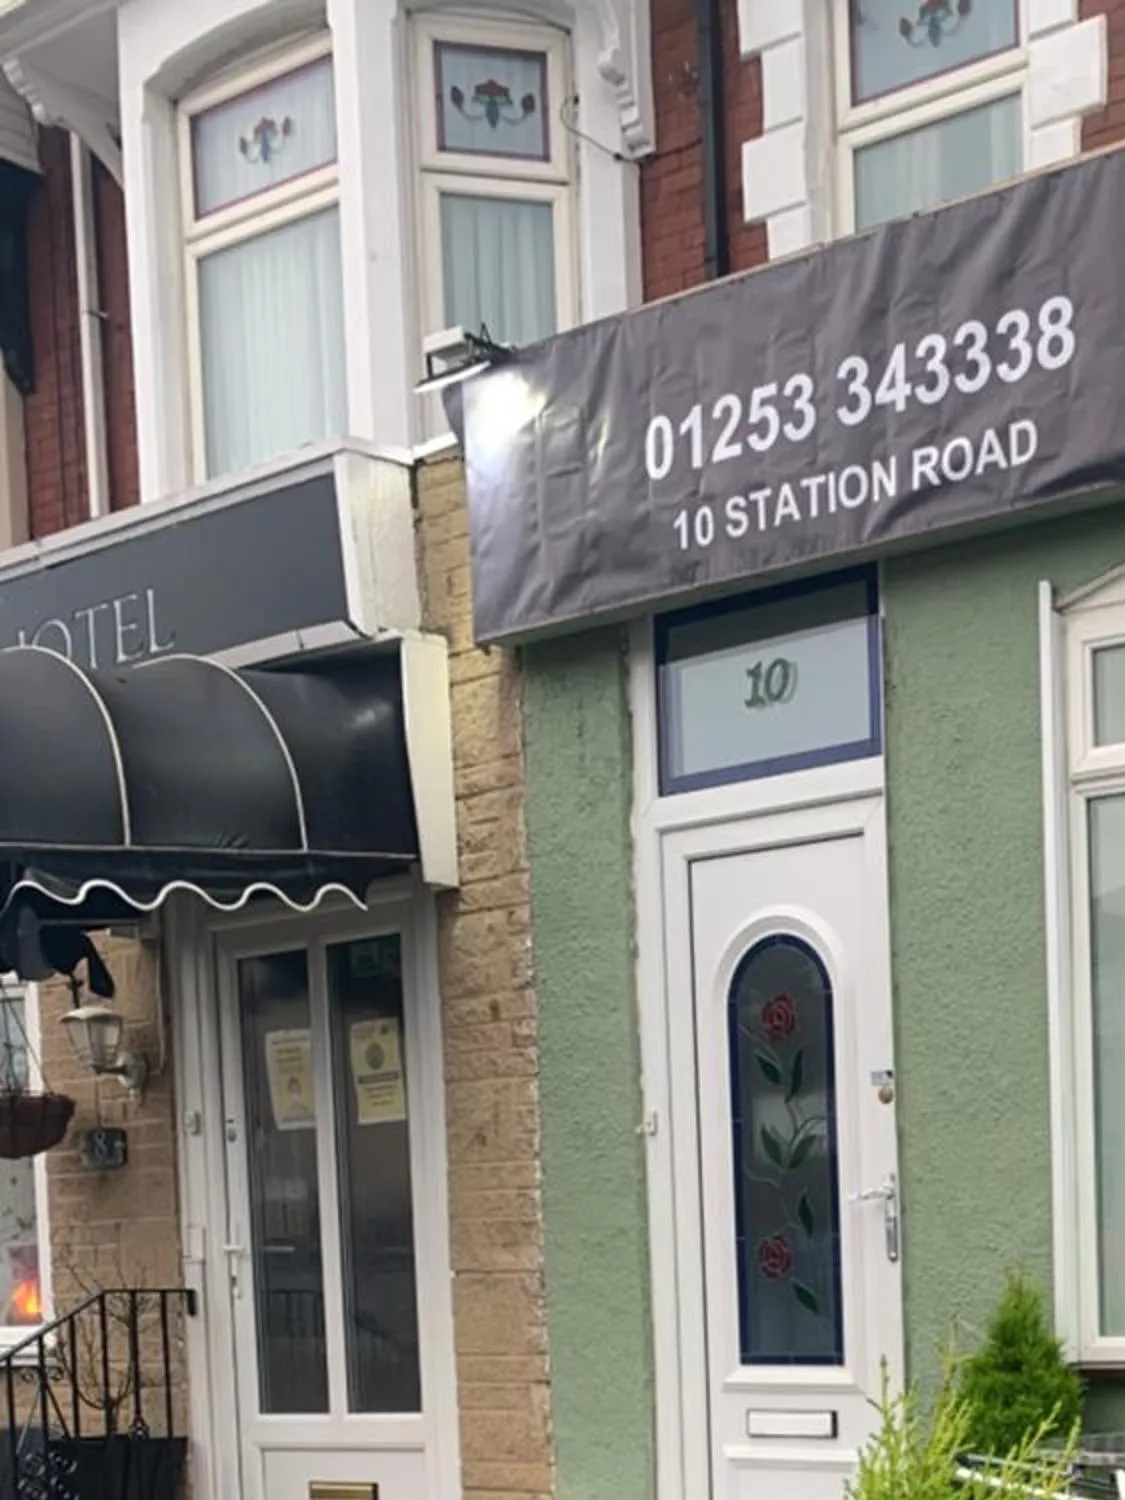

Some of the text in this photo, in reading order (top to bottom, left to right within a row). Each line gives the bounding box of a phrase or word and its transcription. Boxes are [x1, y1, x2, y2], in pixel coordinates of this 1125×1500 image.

[644, 296, 1076, 481] 01253 343338
[672, 419, 1039, 551] 10 STATION ROAD
[17, 588, 175, 669] OTEL
[743, 658, 796, 707] 10
